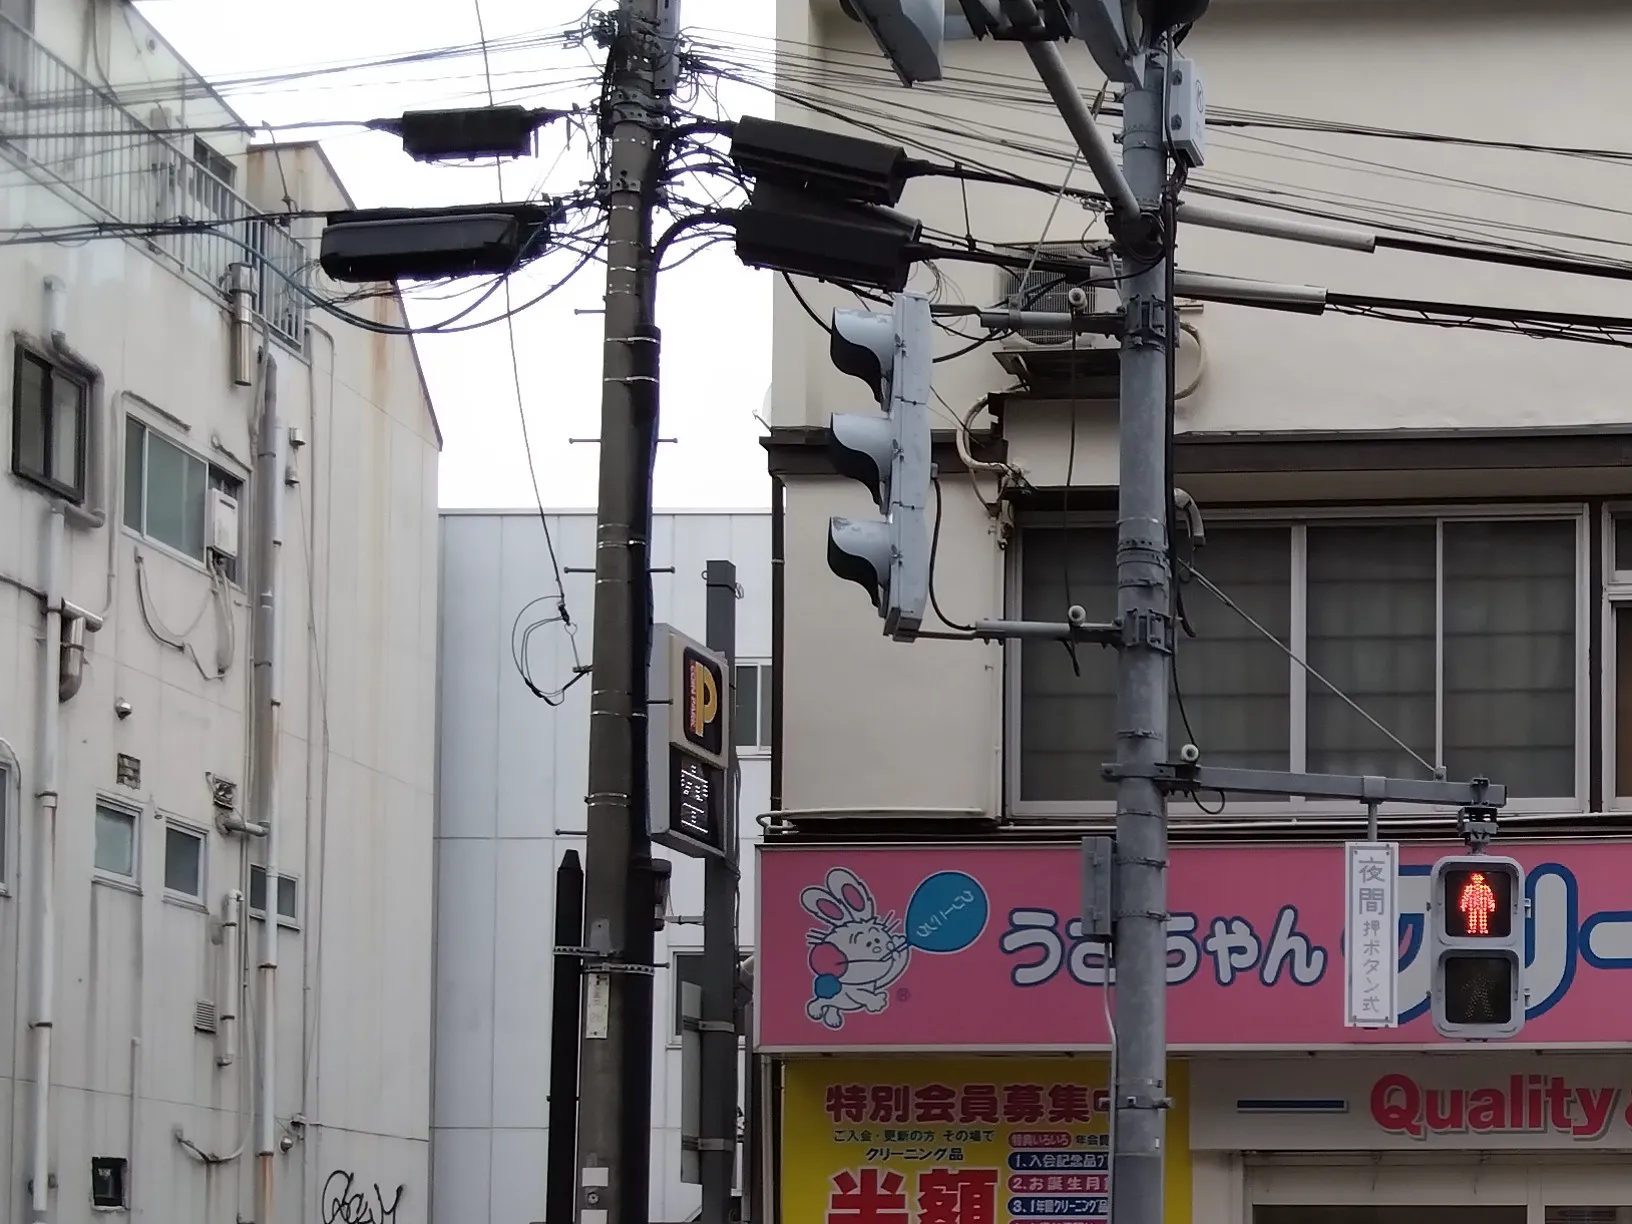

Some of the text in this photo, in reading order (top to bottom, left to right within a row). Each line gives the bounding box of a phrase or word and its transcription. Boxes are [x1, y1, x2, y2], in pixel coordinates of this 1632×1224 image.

[1358, 857, 1385, 1013] 夜間押ボタン式
[866, 1147, 964, 1161] クリーニング品
